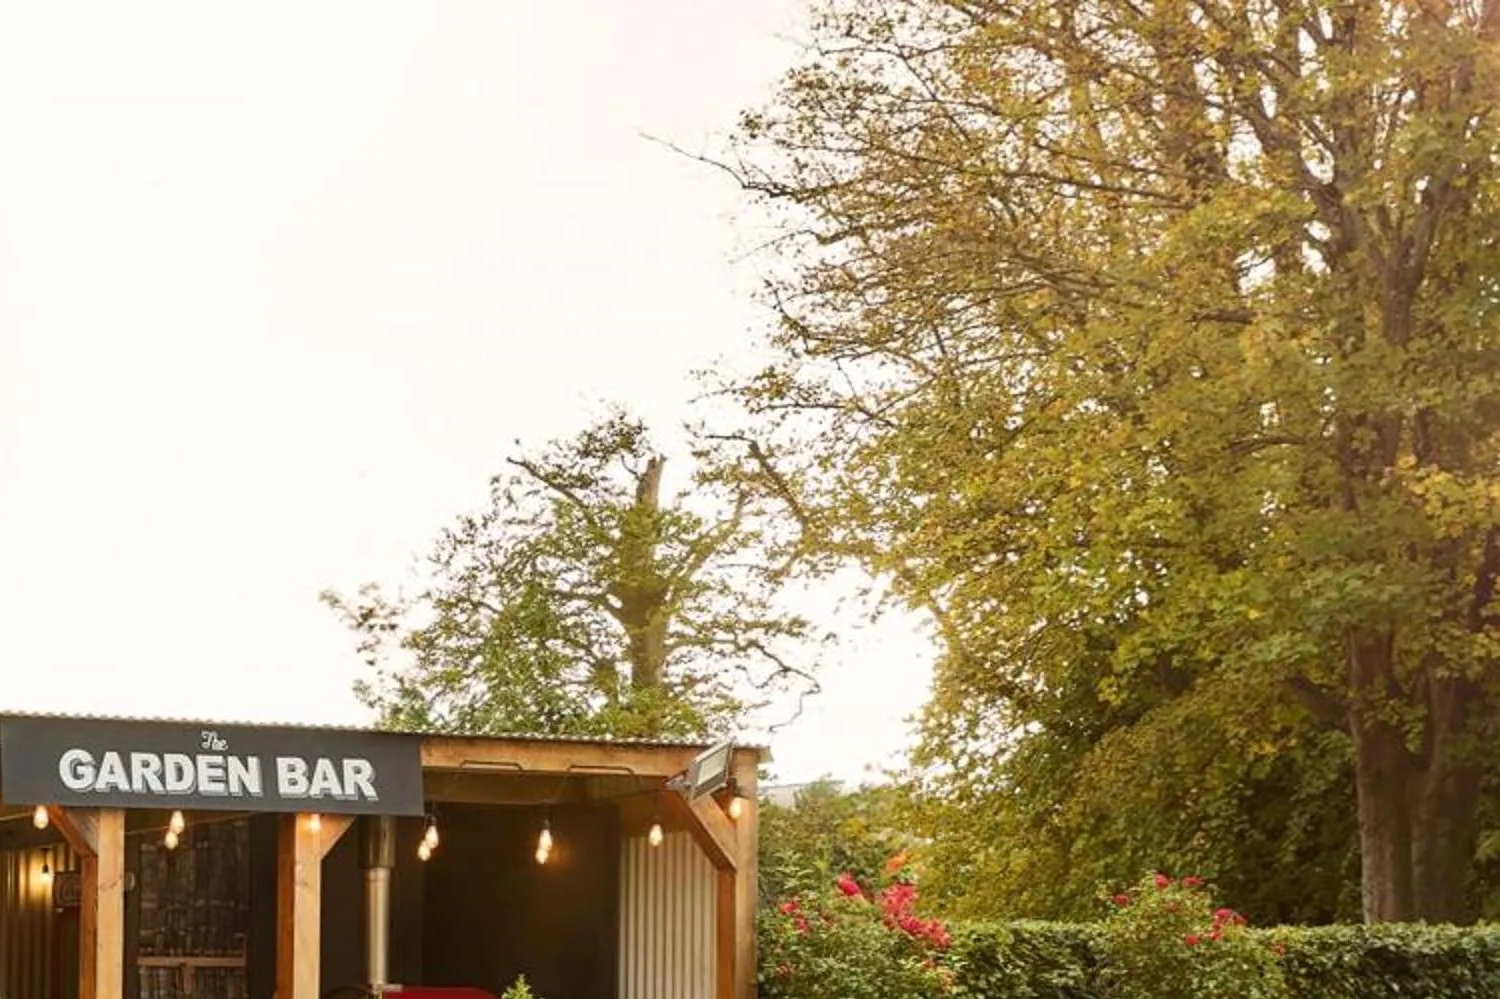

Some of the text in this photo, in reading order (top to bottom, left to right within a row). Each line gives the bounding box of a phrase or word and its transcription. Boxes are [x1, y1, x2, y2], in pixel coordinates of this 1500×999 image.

[200, 730, 229, 750] The
[58, 748, 378, 800] GARDEN BAR
